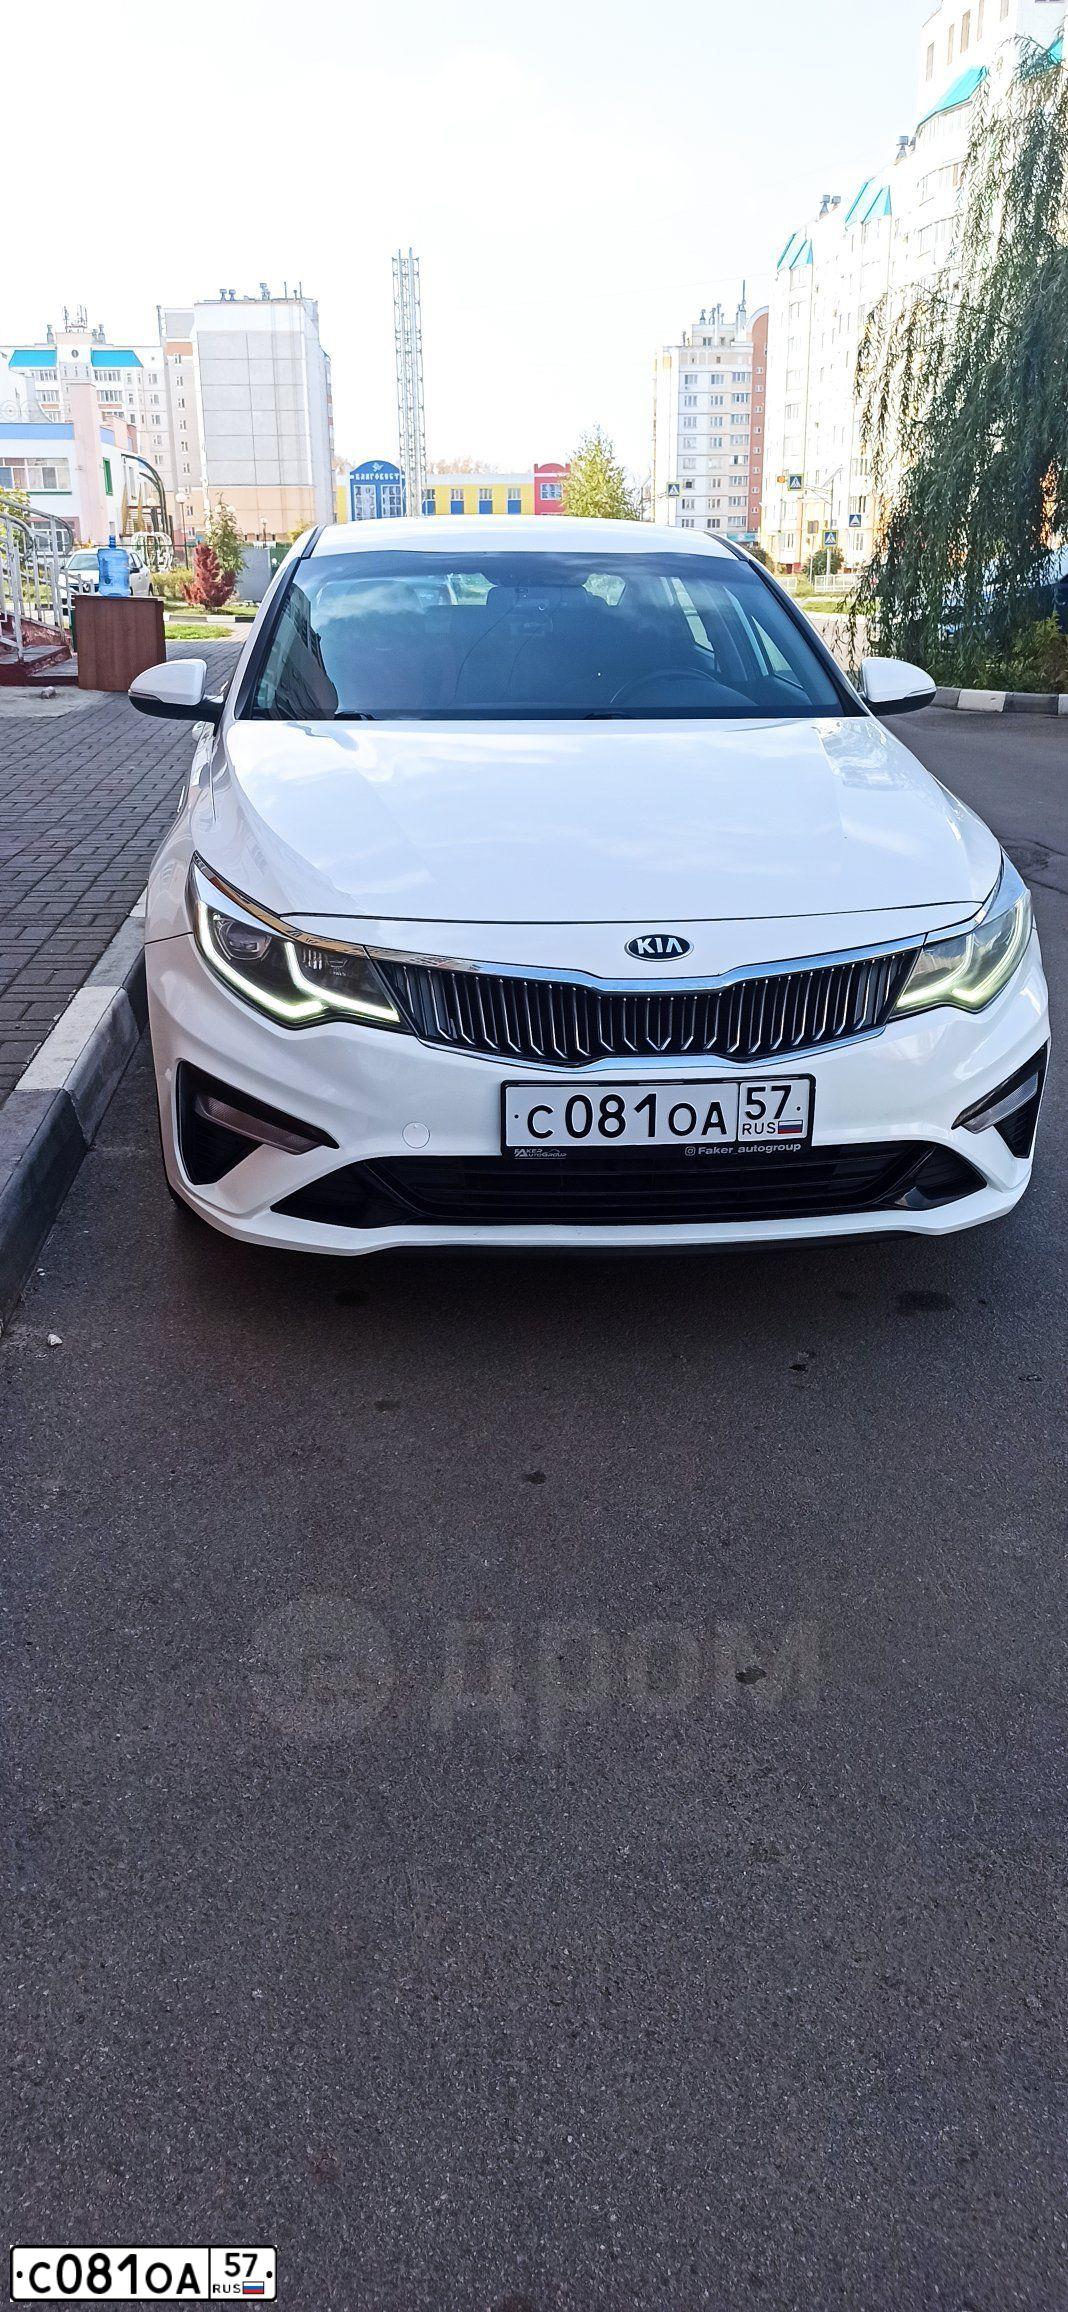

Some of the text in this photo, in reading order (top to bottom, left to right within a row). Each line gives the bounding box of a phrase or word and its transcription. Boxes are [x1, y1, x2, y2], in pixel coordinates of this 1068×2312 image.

[636, 937, 683, 954] KIA
[744, 1085, 792, 1120] 57
[742, 1121, 777, 1136] RUS
[697, 1143, 802, 1155] Faker_autogroup
